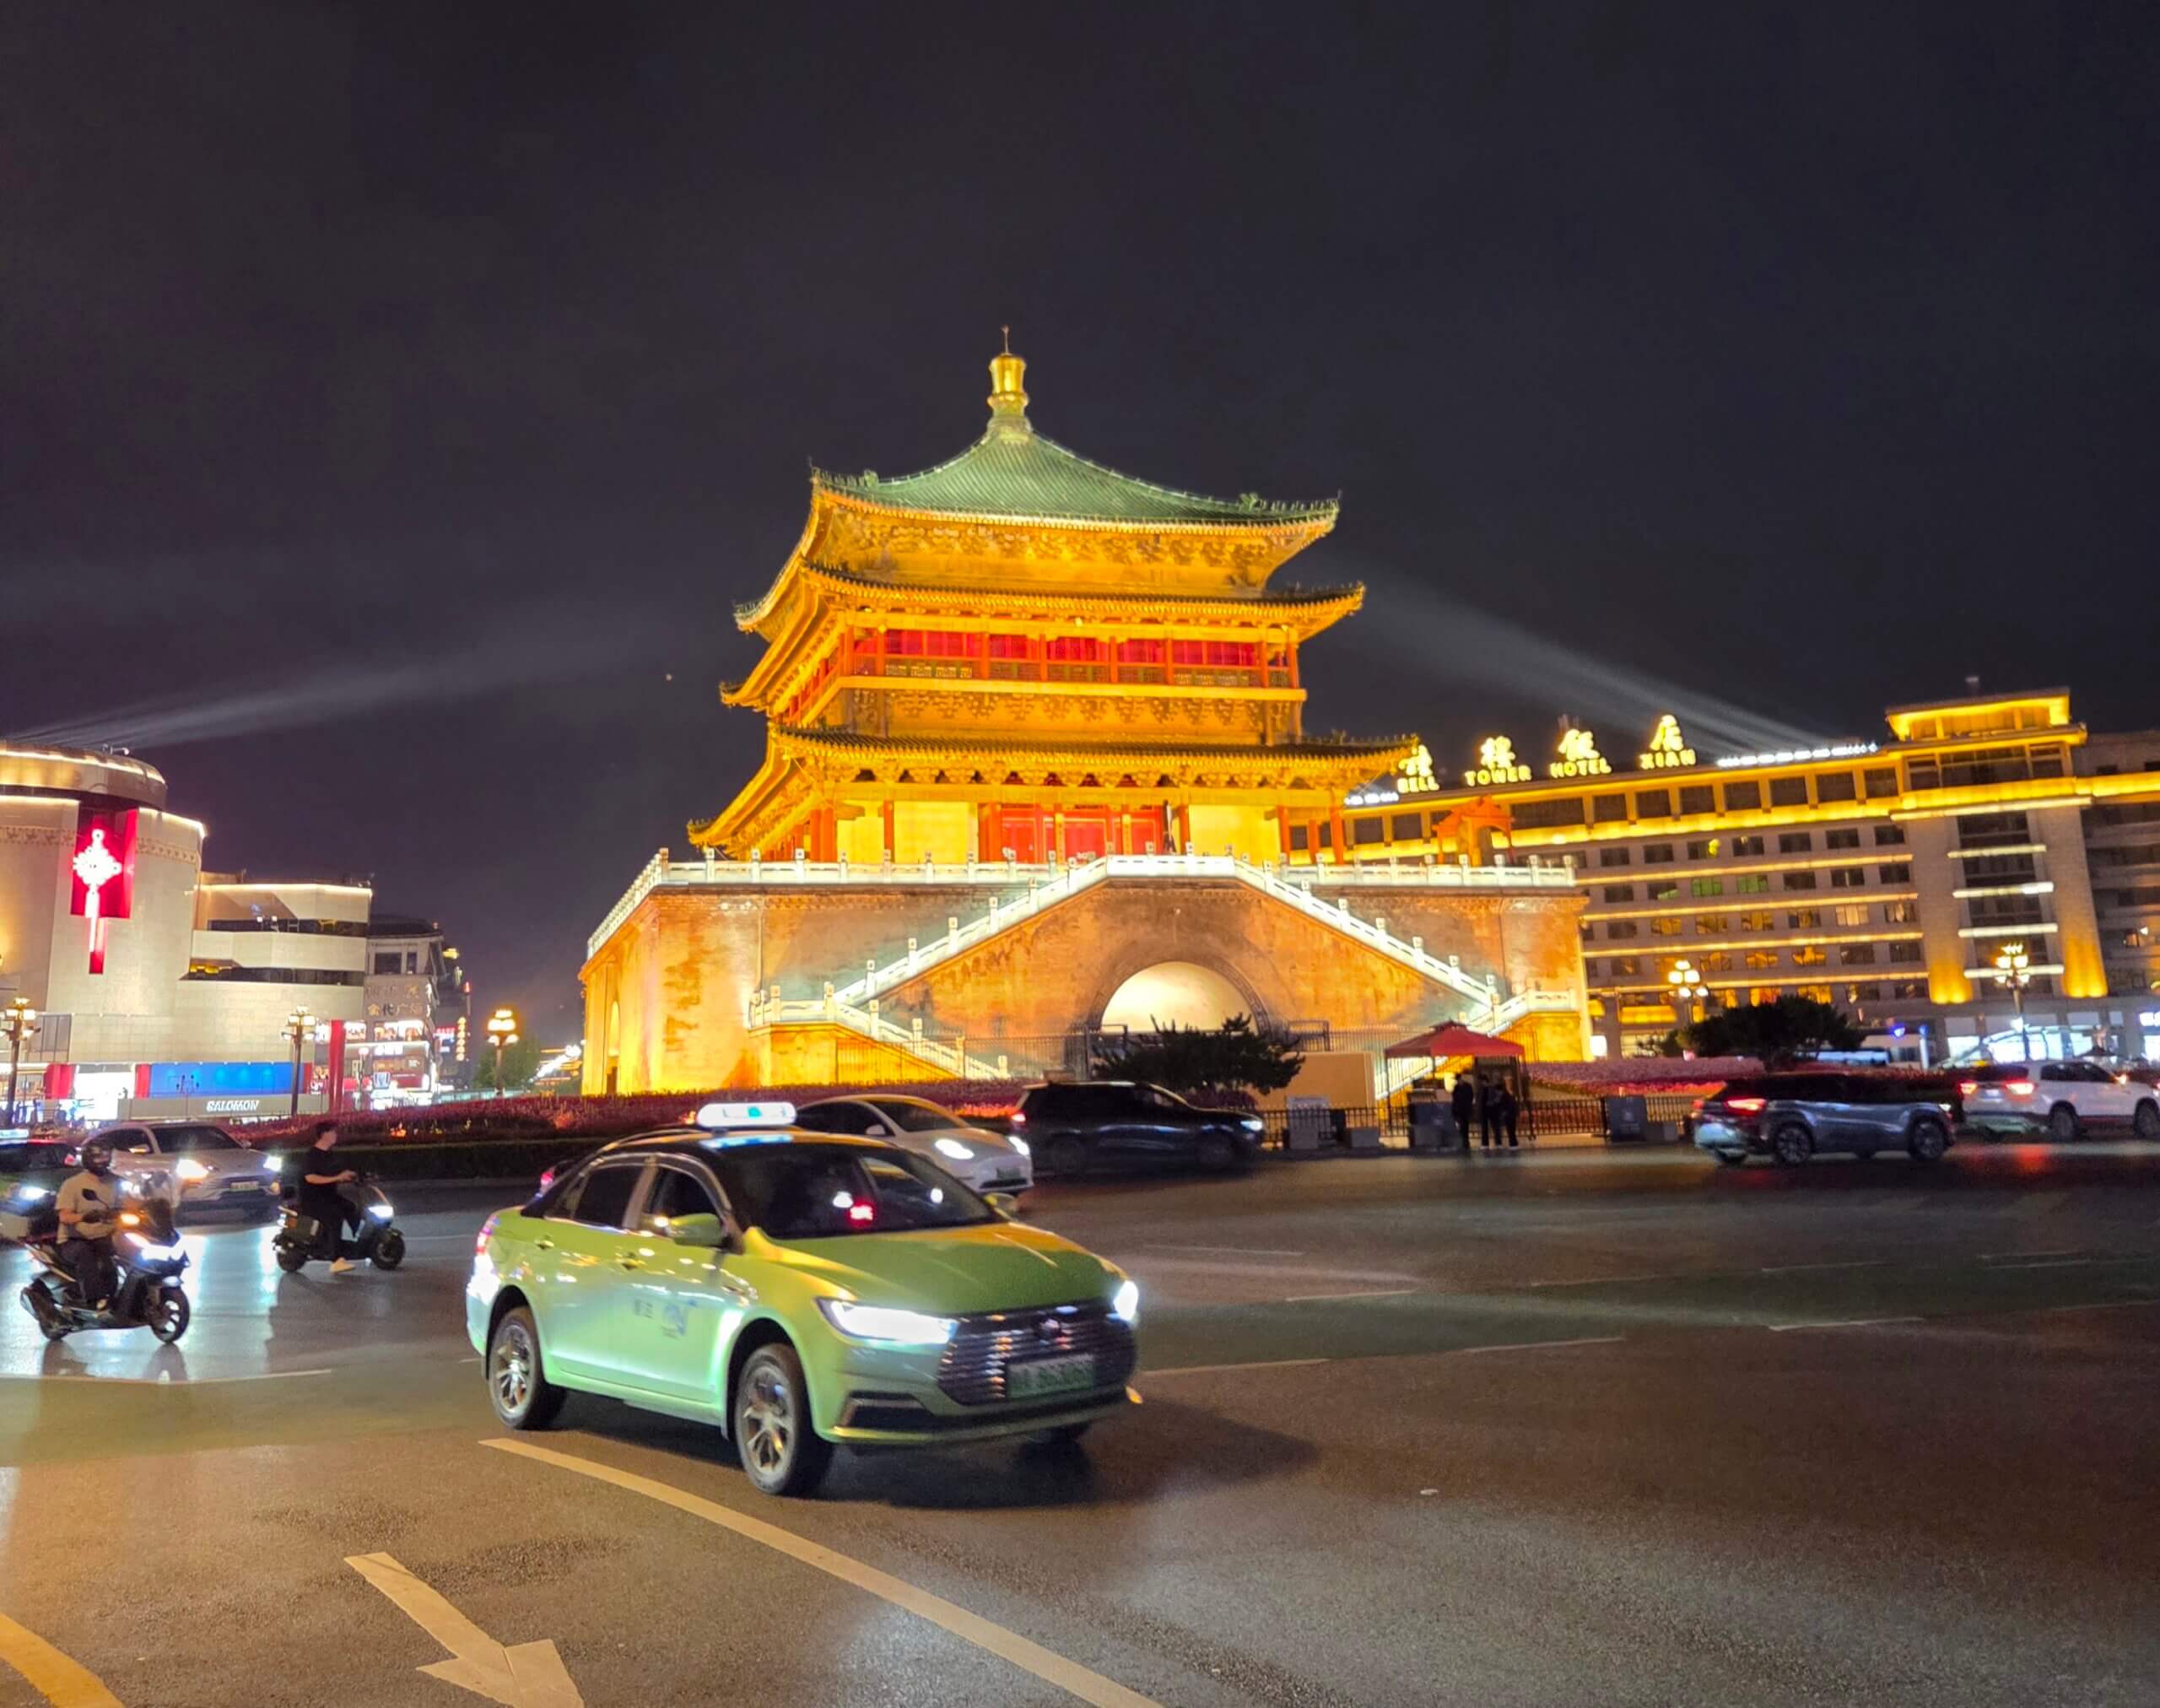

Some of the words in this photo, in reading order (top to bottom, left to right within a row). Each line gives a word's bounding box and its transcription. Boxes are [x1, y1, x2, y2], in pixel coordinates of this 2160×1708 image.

[1397, 776, 1439, 793] BELL
[1465, 765, 1531, 786] TOWER
[1549, 757, 1612, 778] HOTEL
[1639, 749, 1696, 770] XIAN
[206, 1100, 260, 1112] SALOMON
